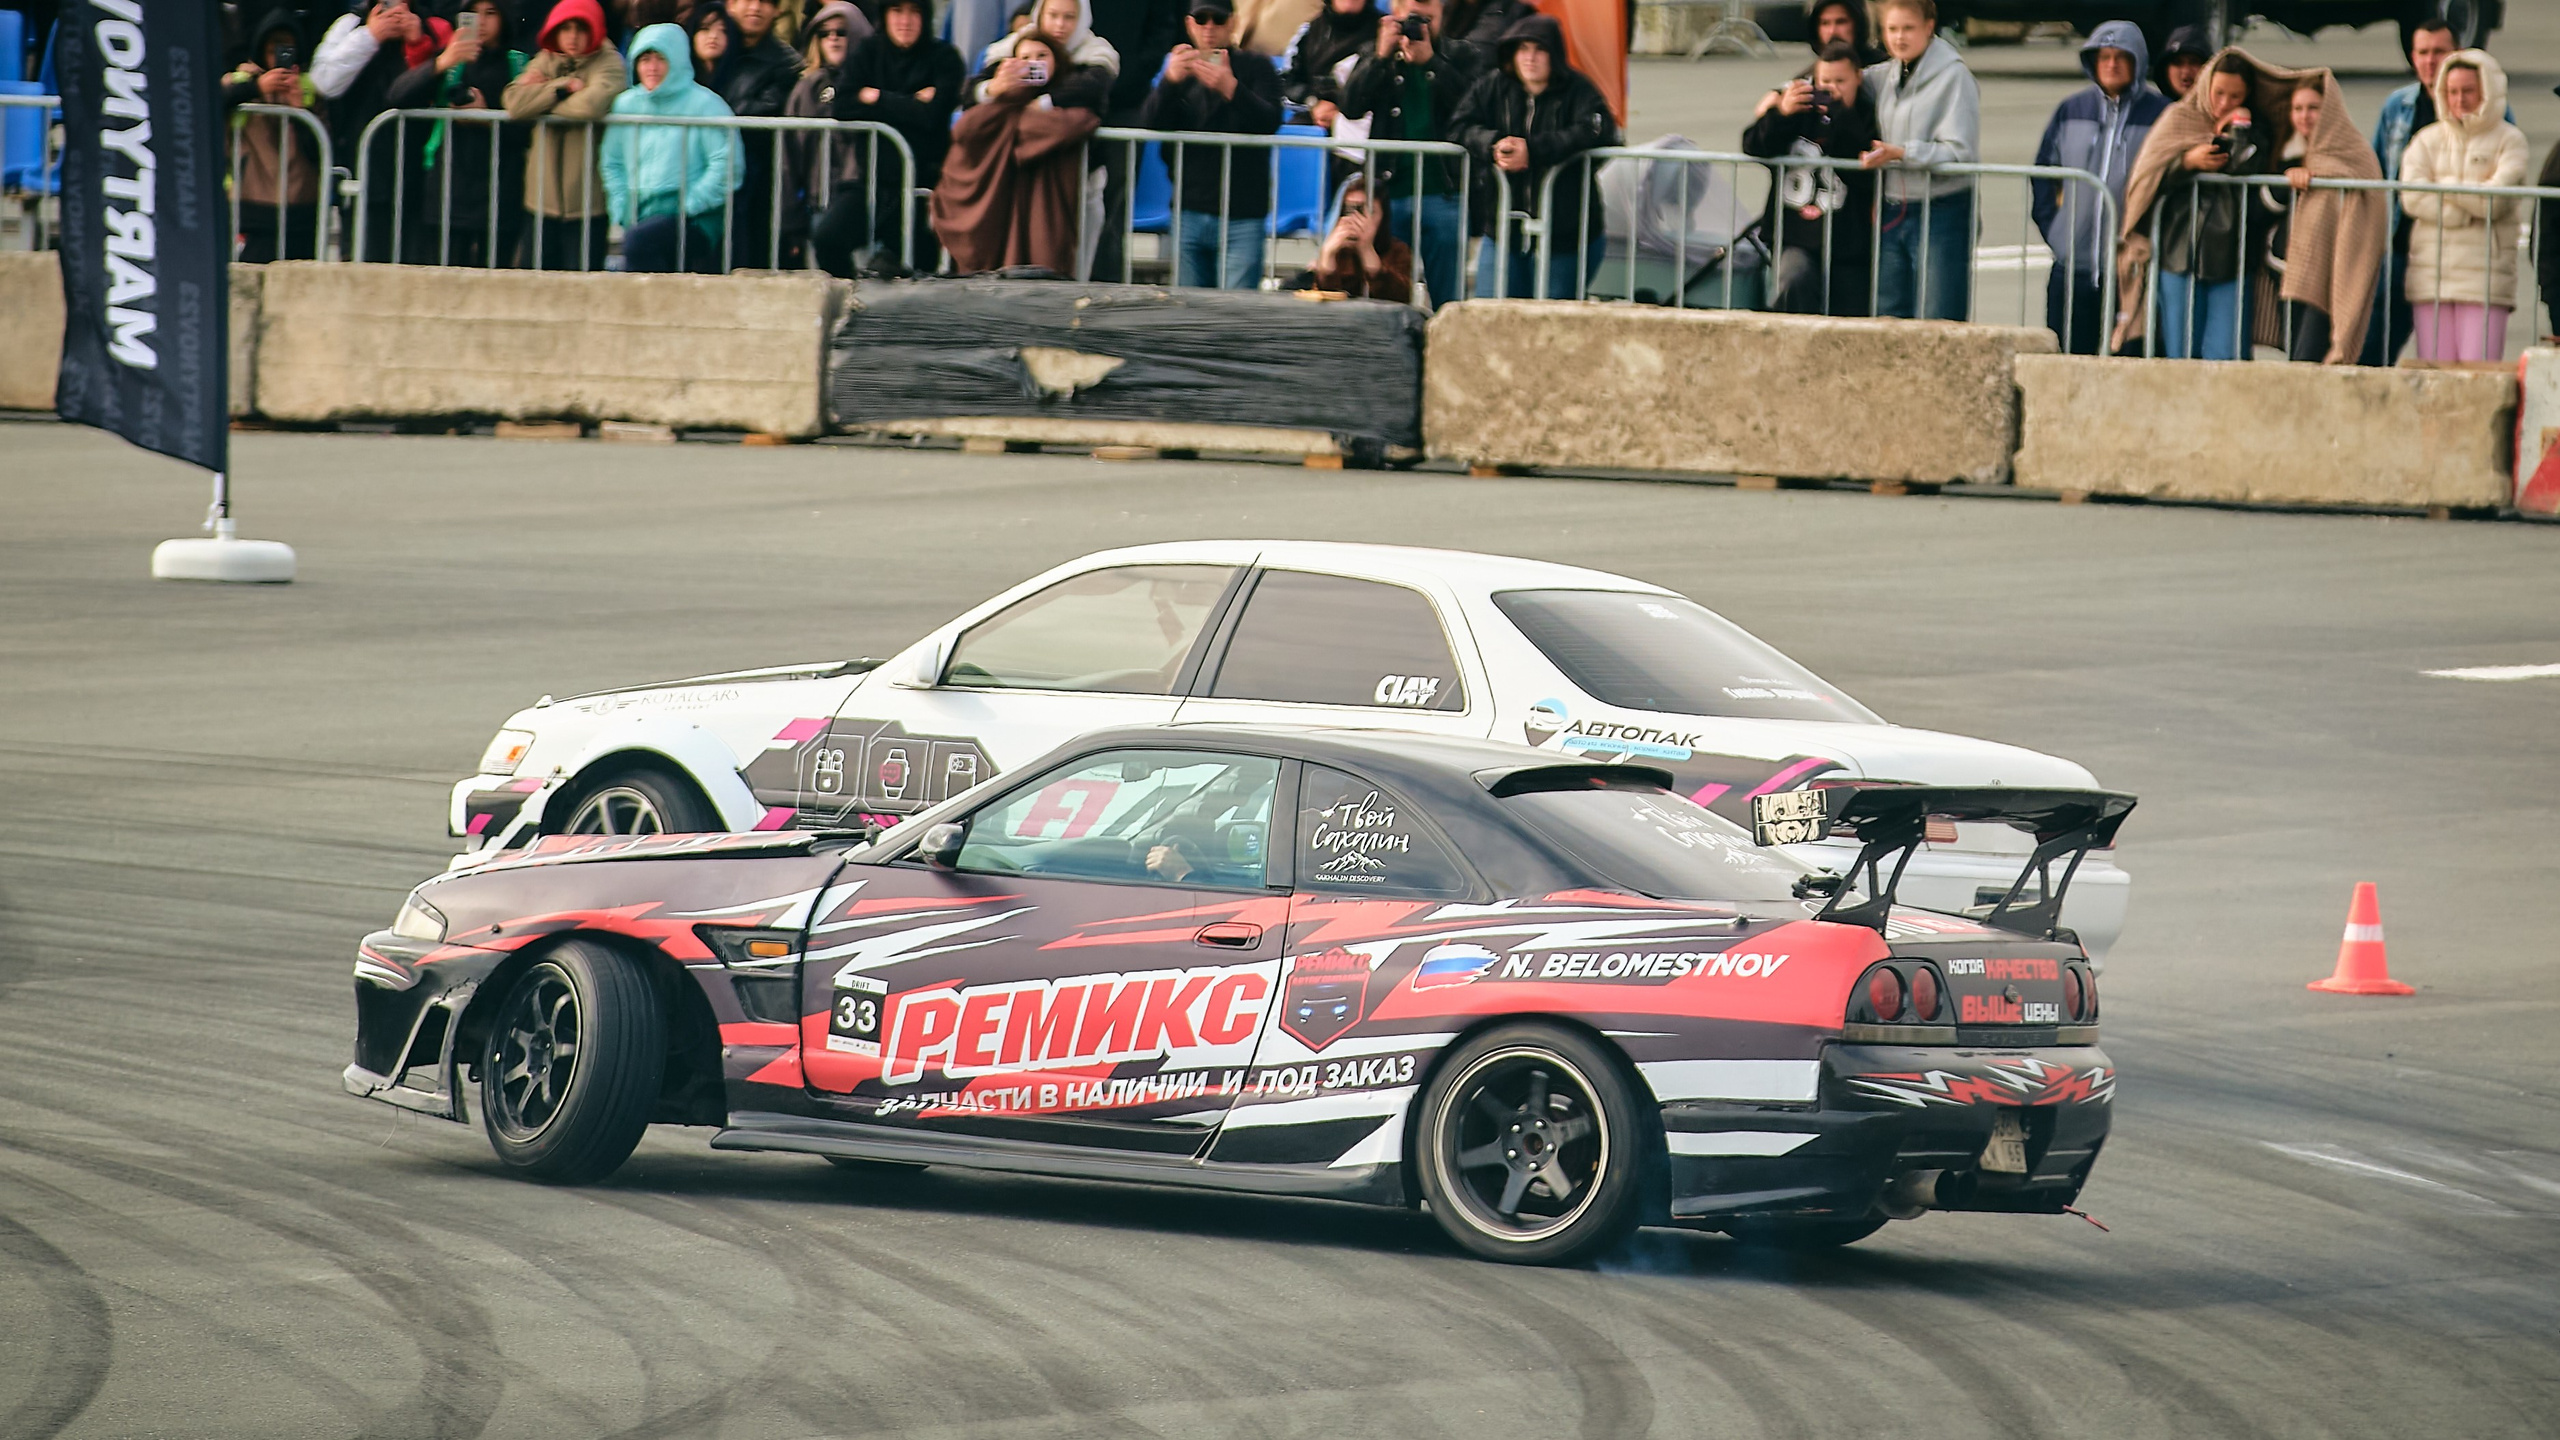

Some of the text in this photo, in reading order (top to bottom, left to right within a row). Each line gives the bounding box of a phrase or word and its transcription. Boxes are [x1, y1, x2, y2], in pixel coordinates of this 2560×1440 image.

[1564, 719, 1703, 748] АВТОПАК
[1340, 790, 1395, 828] Твой
[1312, 822, 1410, 854] Сахалин
[1349, 874, 1385, 883] DISCOVERY
[1500, 952, 1791, 978] N. BELOMESTNOV
[1985, 958, 2059, 981] КАЧЕСТВО
[851, 979, 870, 990] DRIFT
[837, 995, 877, 1033] 33
[1961, 994, 2059, 1023] ВЫШЕ ЦЕНЫ
[887, 970, 1269, 1080] РЕМИКС
[1039, 1083, 1059, 1110] В
[1065, 1070, 1209, 1108] НАЛИЧИИ
[1219, 1069, 1245, 1095] И
[1254, 1064, 1319, 1096] ПОД
[1323, 1055, 1416, 1089] ЗАКАЗ
